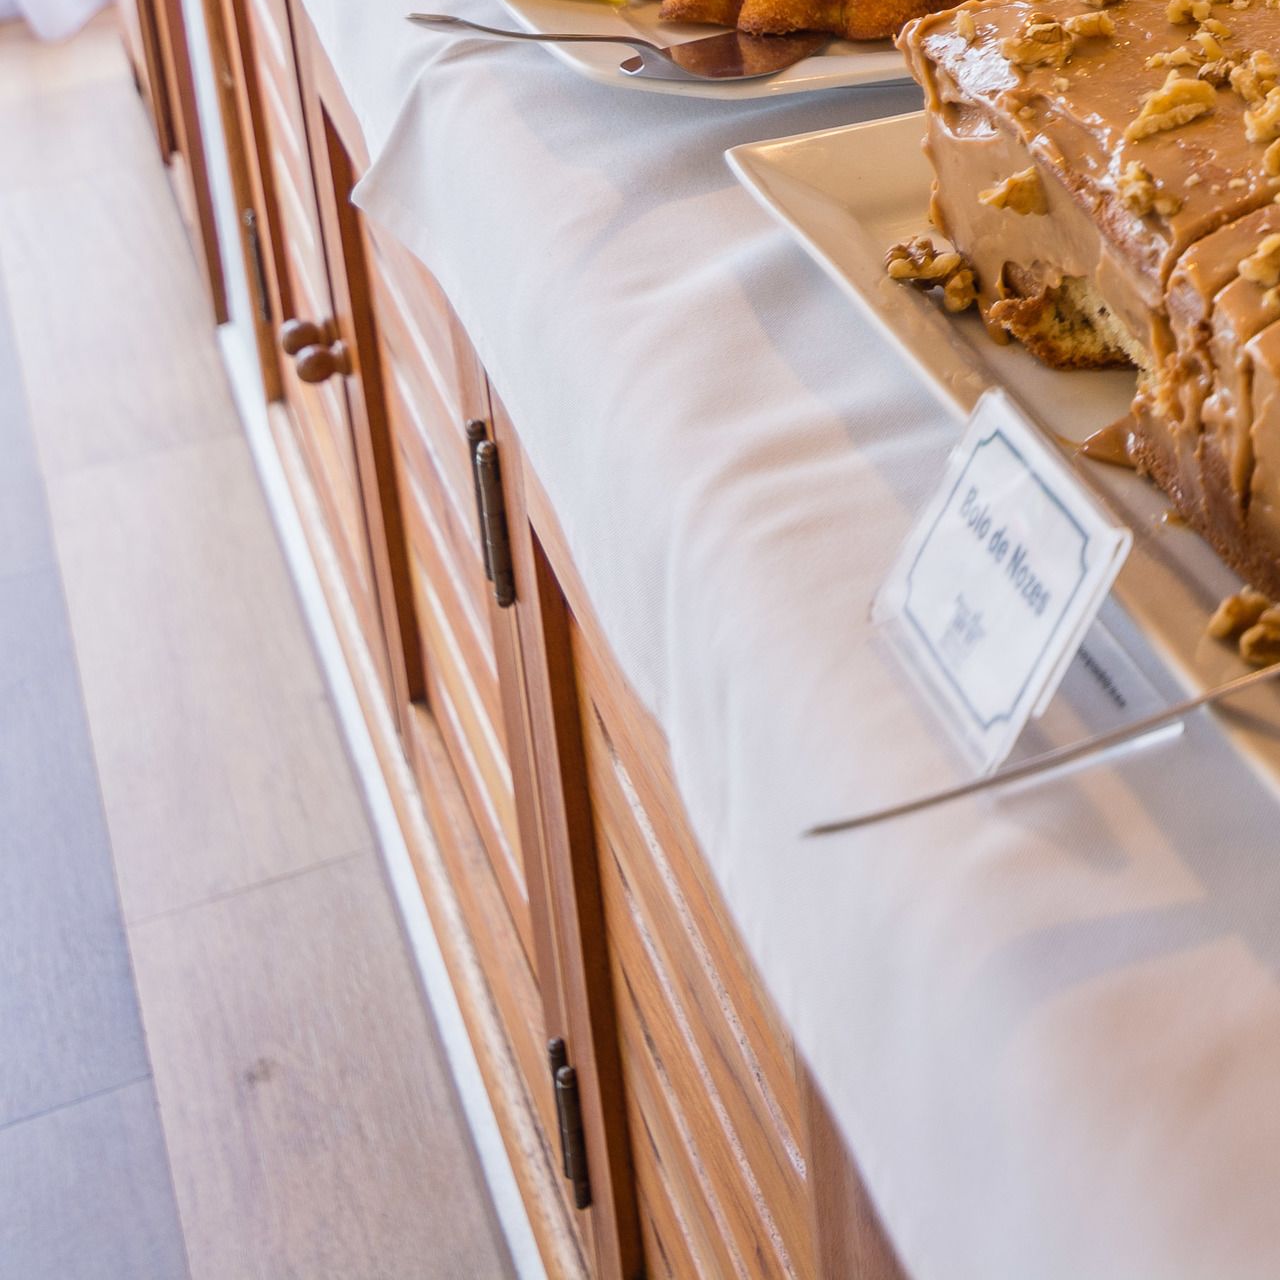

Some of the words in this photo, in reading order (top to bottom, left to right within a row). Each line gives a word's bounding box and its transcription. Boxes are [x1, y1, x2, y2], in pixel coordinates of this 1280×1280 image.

[959, 486, 991, 540] Bolo
[988, 525, 1010, 562] de
[1006, 543, 1050, 615] Nozes
